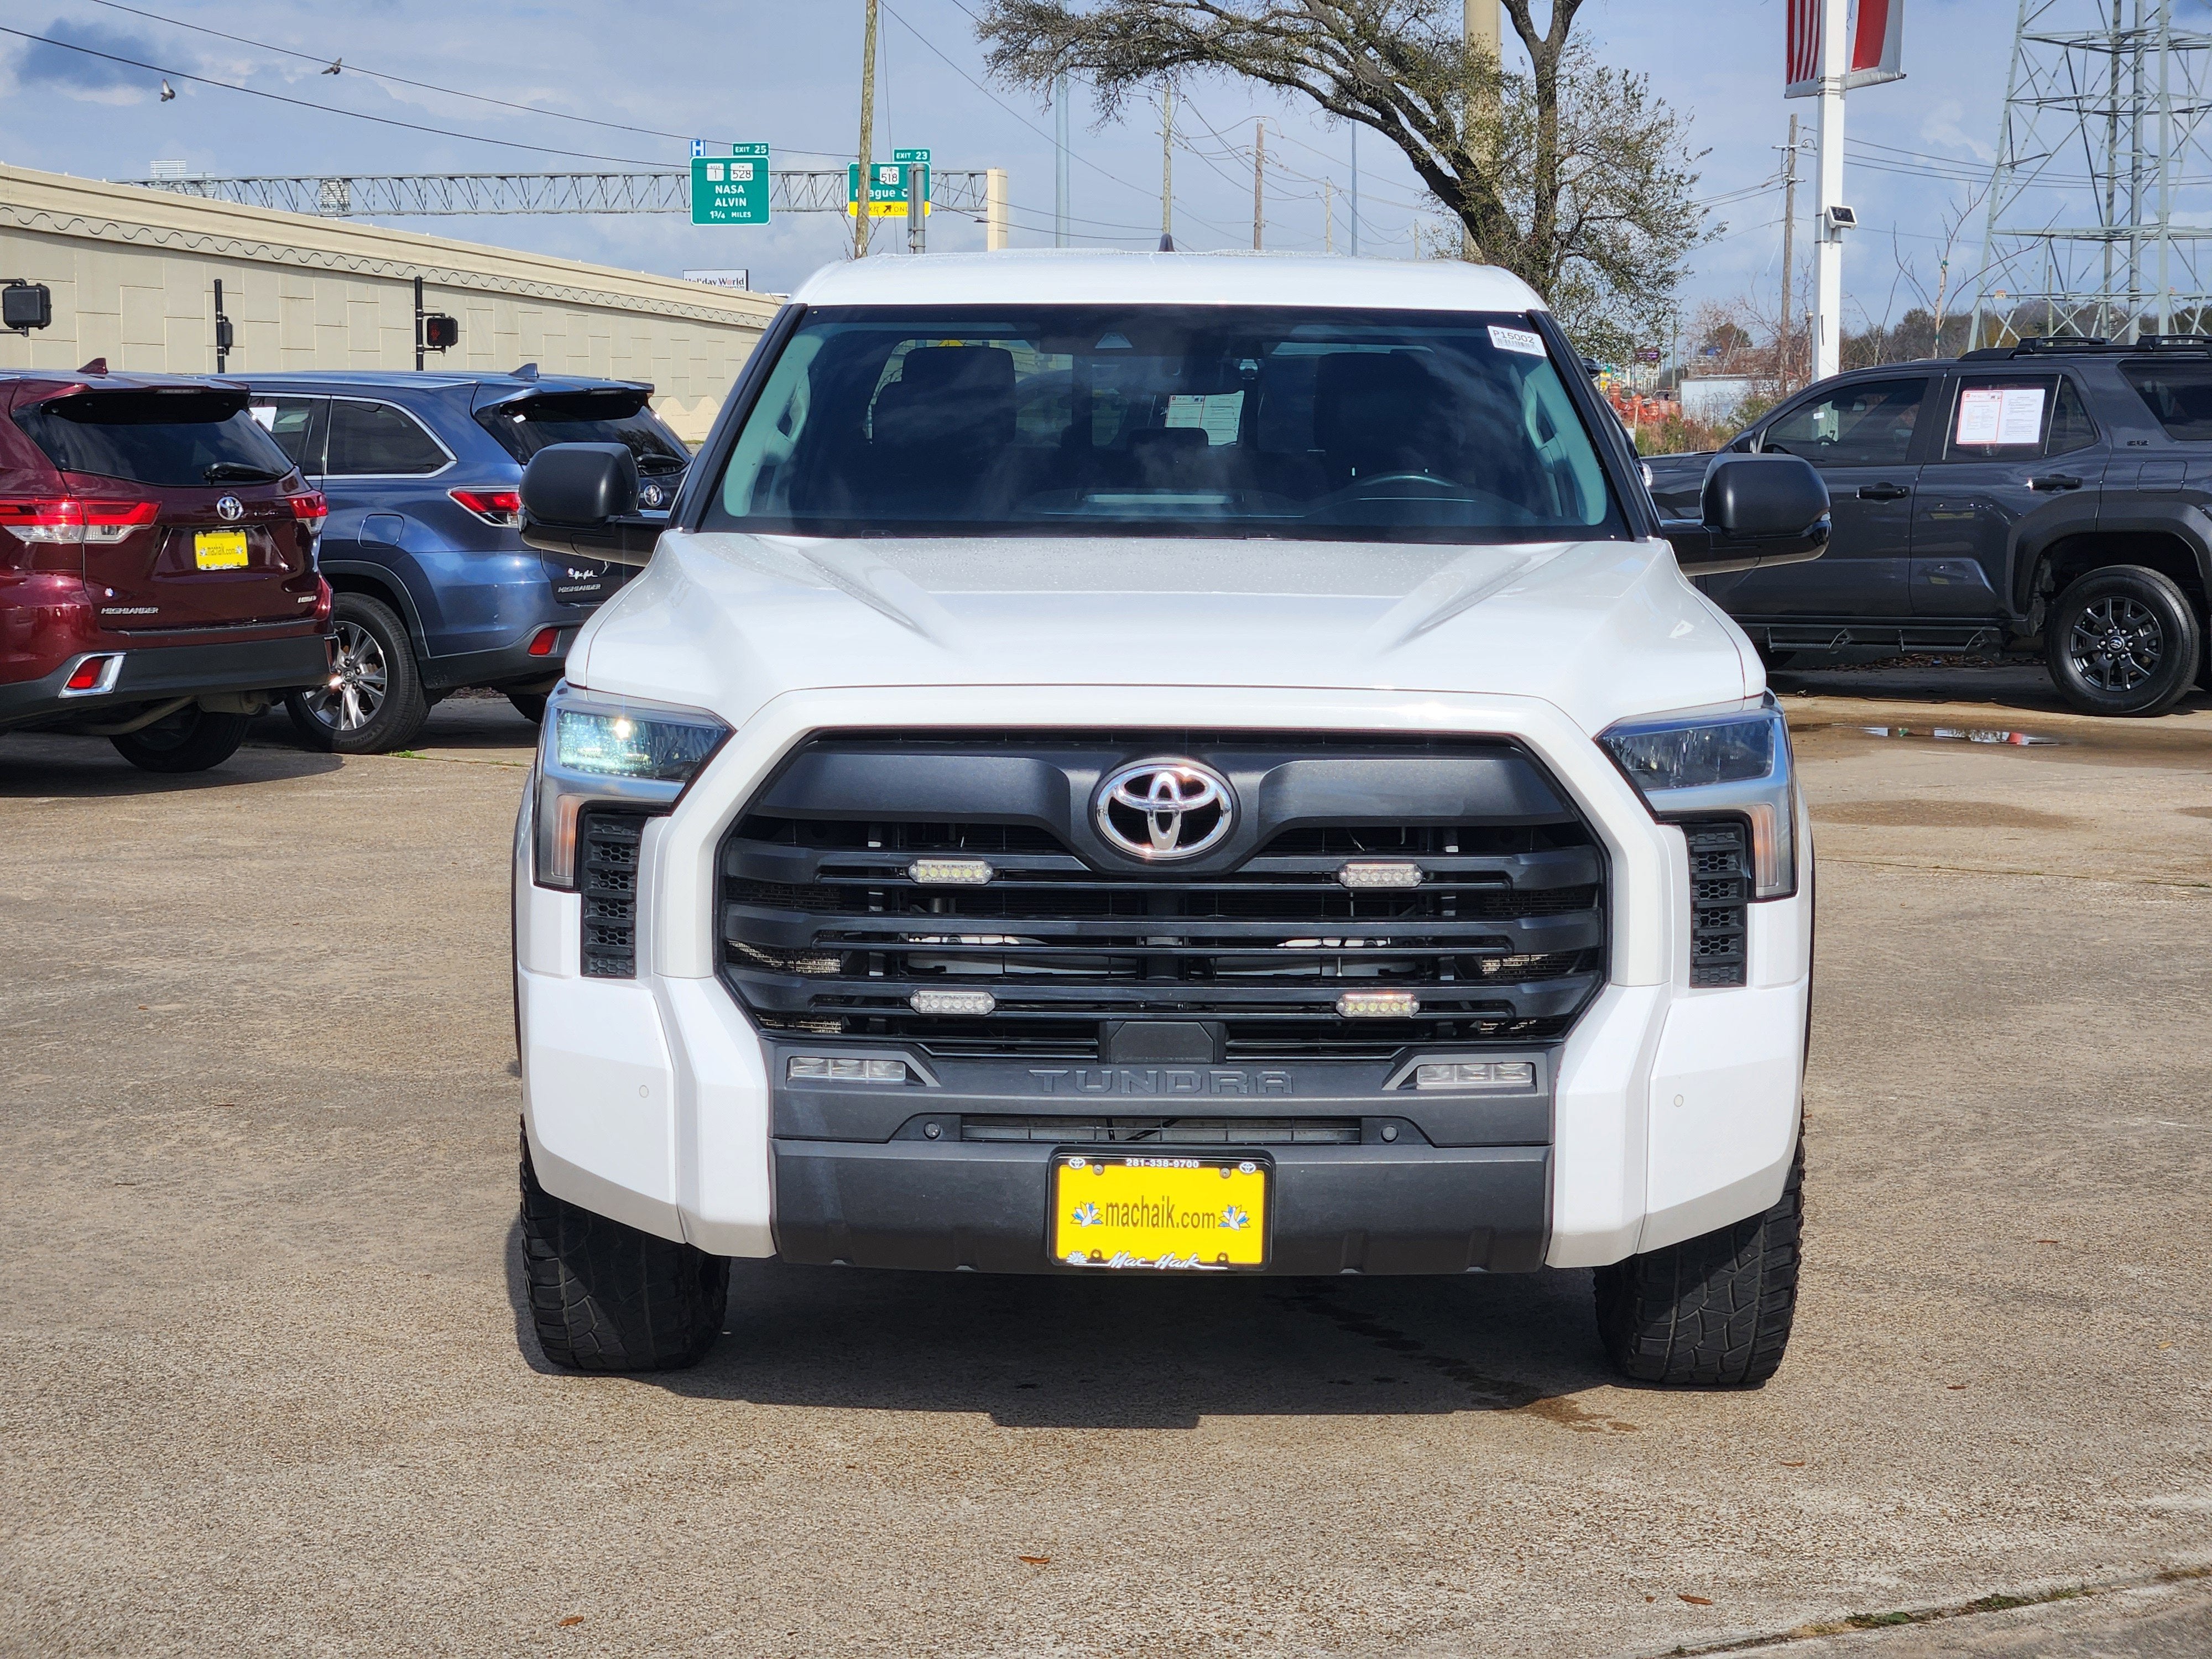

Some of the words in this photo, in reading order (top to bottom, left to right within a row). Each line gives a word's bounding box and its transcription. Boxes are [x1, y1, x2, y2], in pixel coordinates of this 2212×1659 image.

[692, 141, 705, 156] H
[754, 145, 767, 154] 25
[915, 151, 927, 160] 23
[733, 170, 751, 179] 528
[881, 173, 898, 182] 518
[715, 185, 745, 194] NASA
[855, 189, 896, 200] ague
[714, 197, 747, 207] ALVIN
[1493, 330, 1535, 344] P15002
[557, 583, 601, 593] HIGHLANDER
[1029, 1070, 1293, 1094] TUNDRA
[1126, 1158, 1199, 1168] 281-338-9700
[1105, 1195, 1215, 1229] machaik.com
[1107, 1250, 1153, 1268] Mac
[1153, 1252, 1202, 1270] Haik
